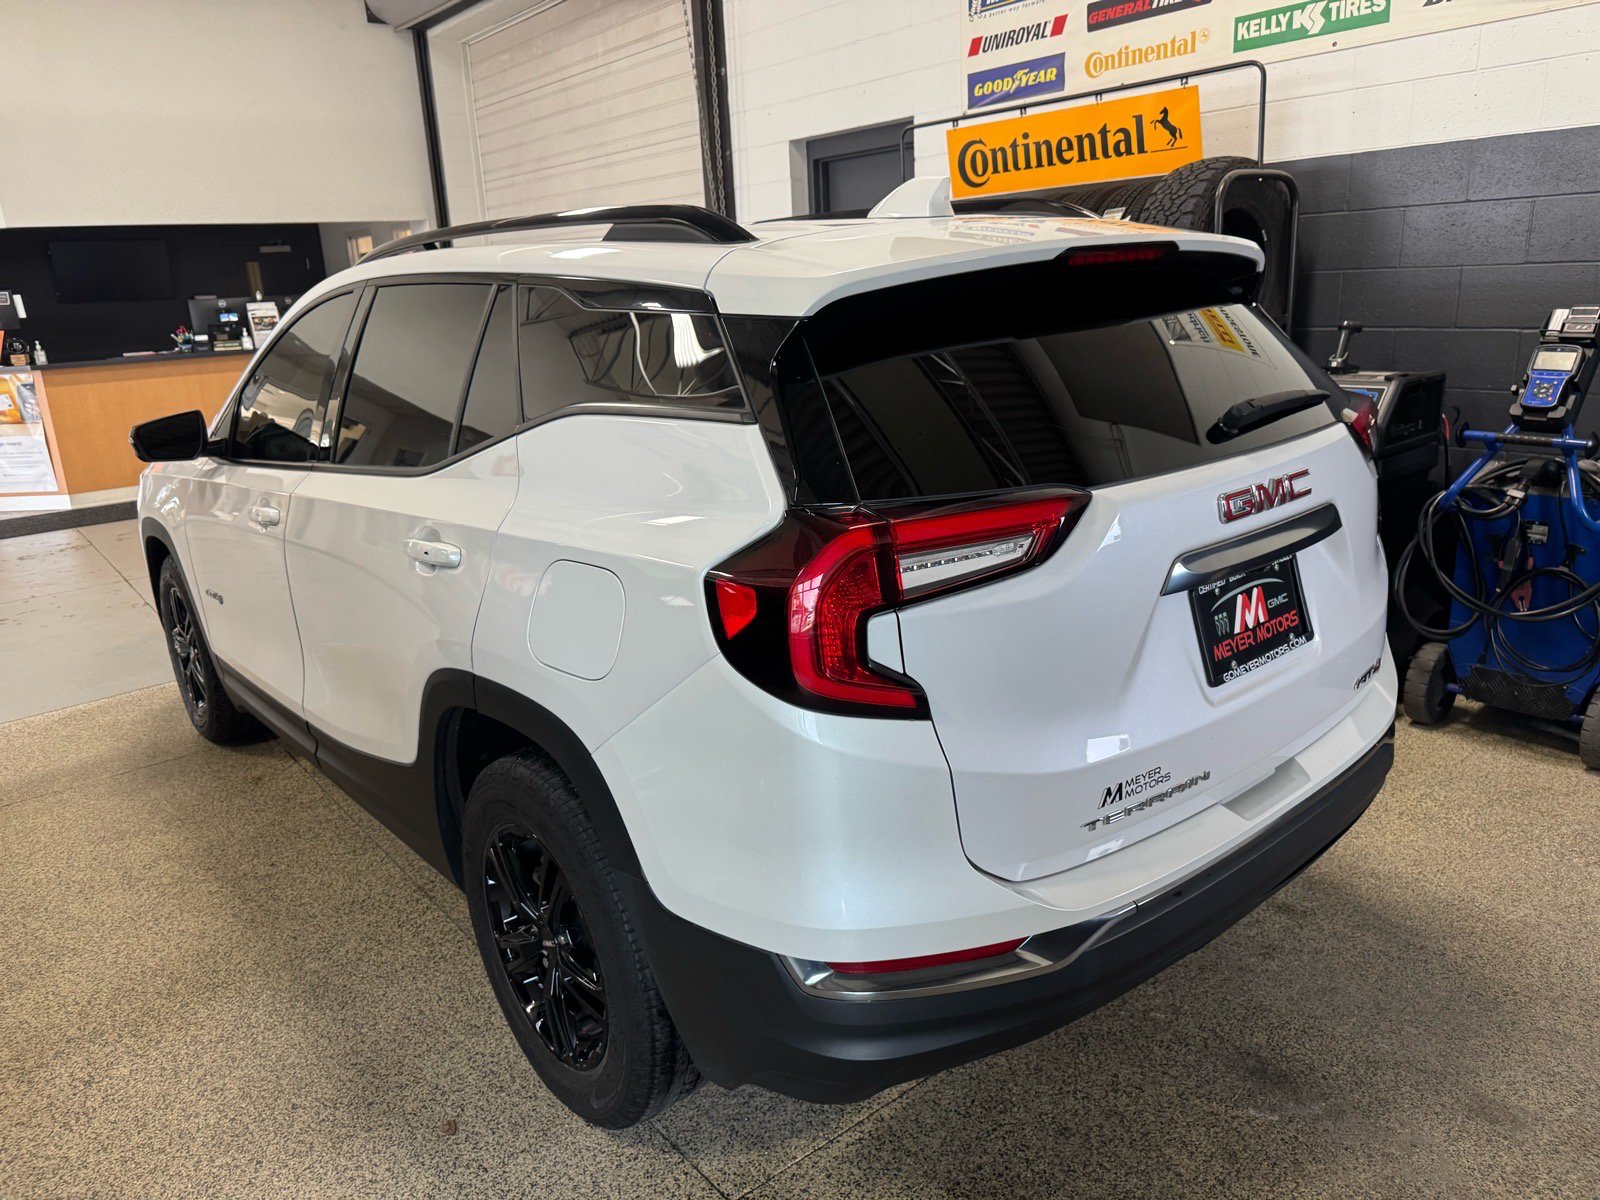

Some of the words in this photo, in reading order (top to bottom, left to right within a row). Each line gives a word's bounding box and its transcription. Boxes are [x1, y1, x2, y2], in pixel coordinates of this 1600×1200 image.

[1088, 0, 1153, 25] GENERAL
[1237, 11, 1291, 41] KELLY
[1328, 0, 1386, 22] TIRES
[982, 21, 1048, 53] UNIROYAL
[1084, 31, 1197, 79] Continental
[974, 67, 1057, 97] GOODYEAR
[957, 114, 1148, 188] Continental
[1217, 468, 1312, 524] GMC
[1267, 593, 1289, 608] GMC
[1213, 632, 1256, 662] MEYER
[1256, 609, 1299, 643] MOTORS
[1222, 635, 1307, 682] GOMEYERMOTORS.COM
[1125, 766, 1162, 789] MEYER
[1125, 772, 1172, 800] MOTORS
[1080, 770, 1211, 832] TERRAIN
